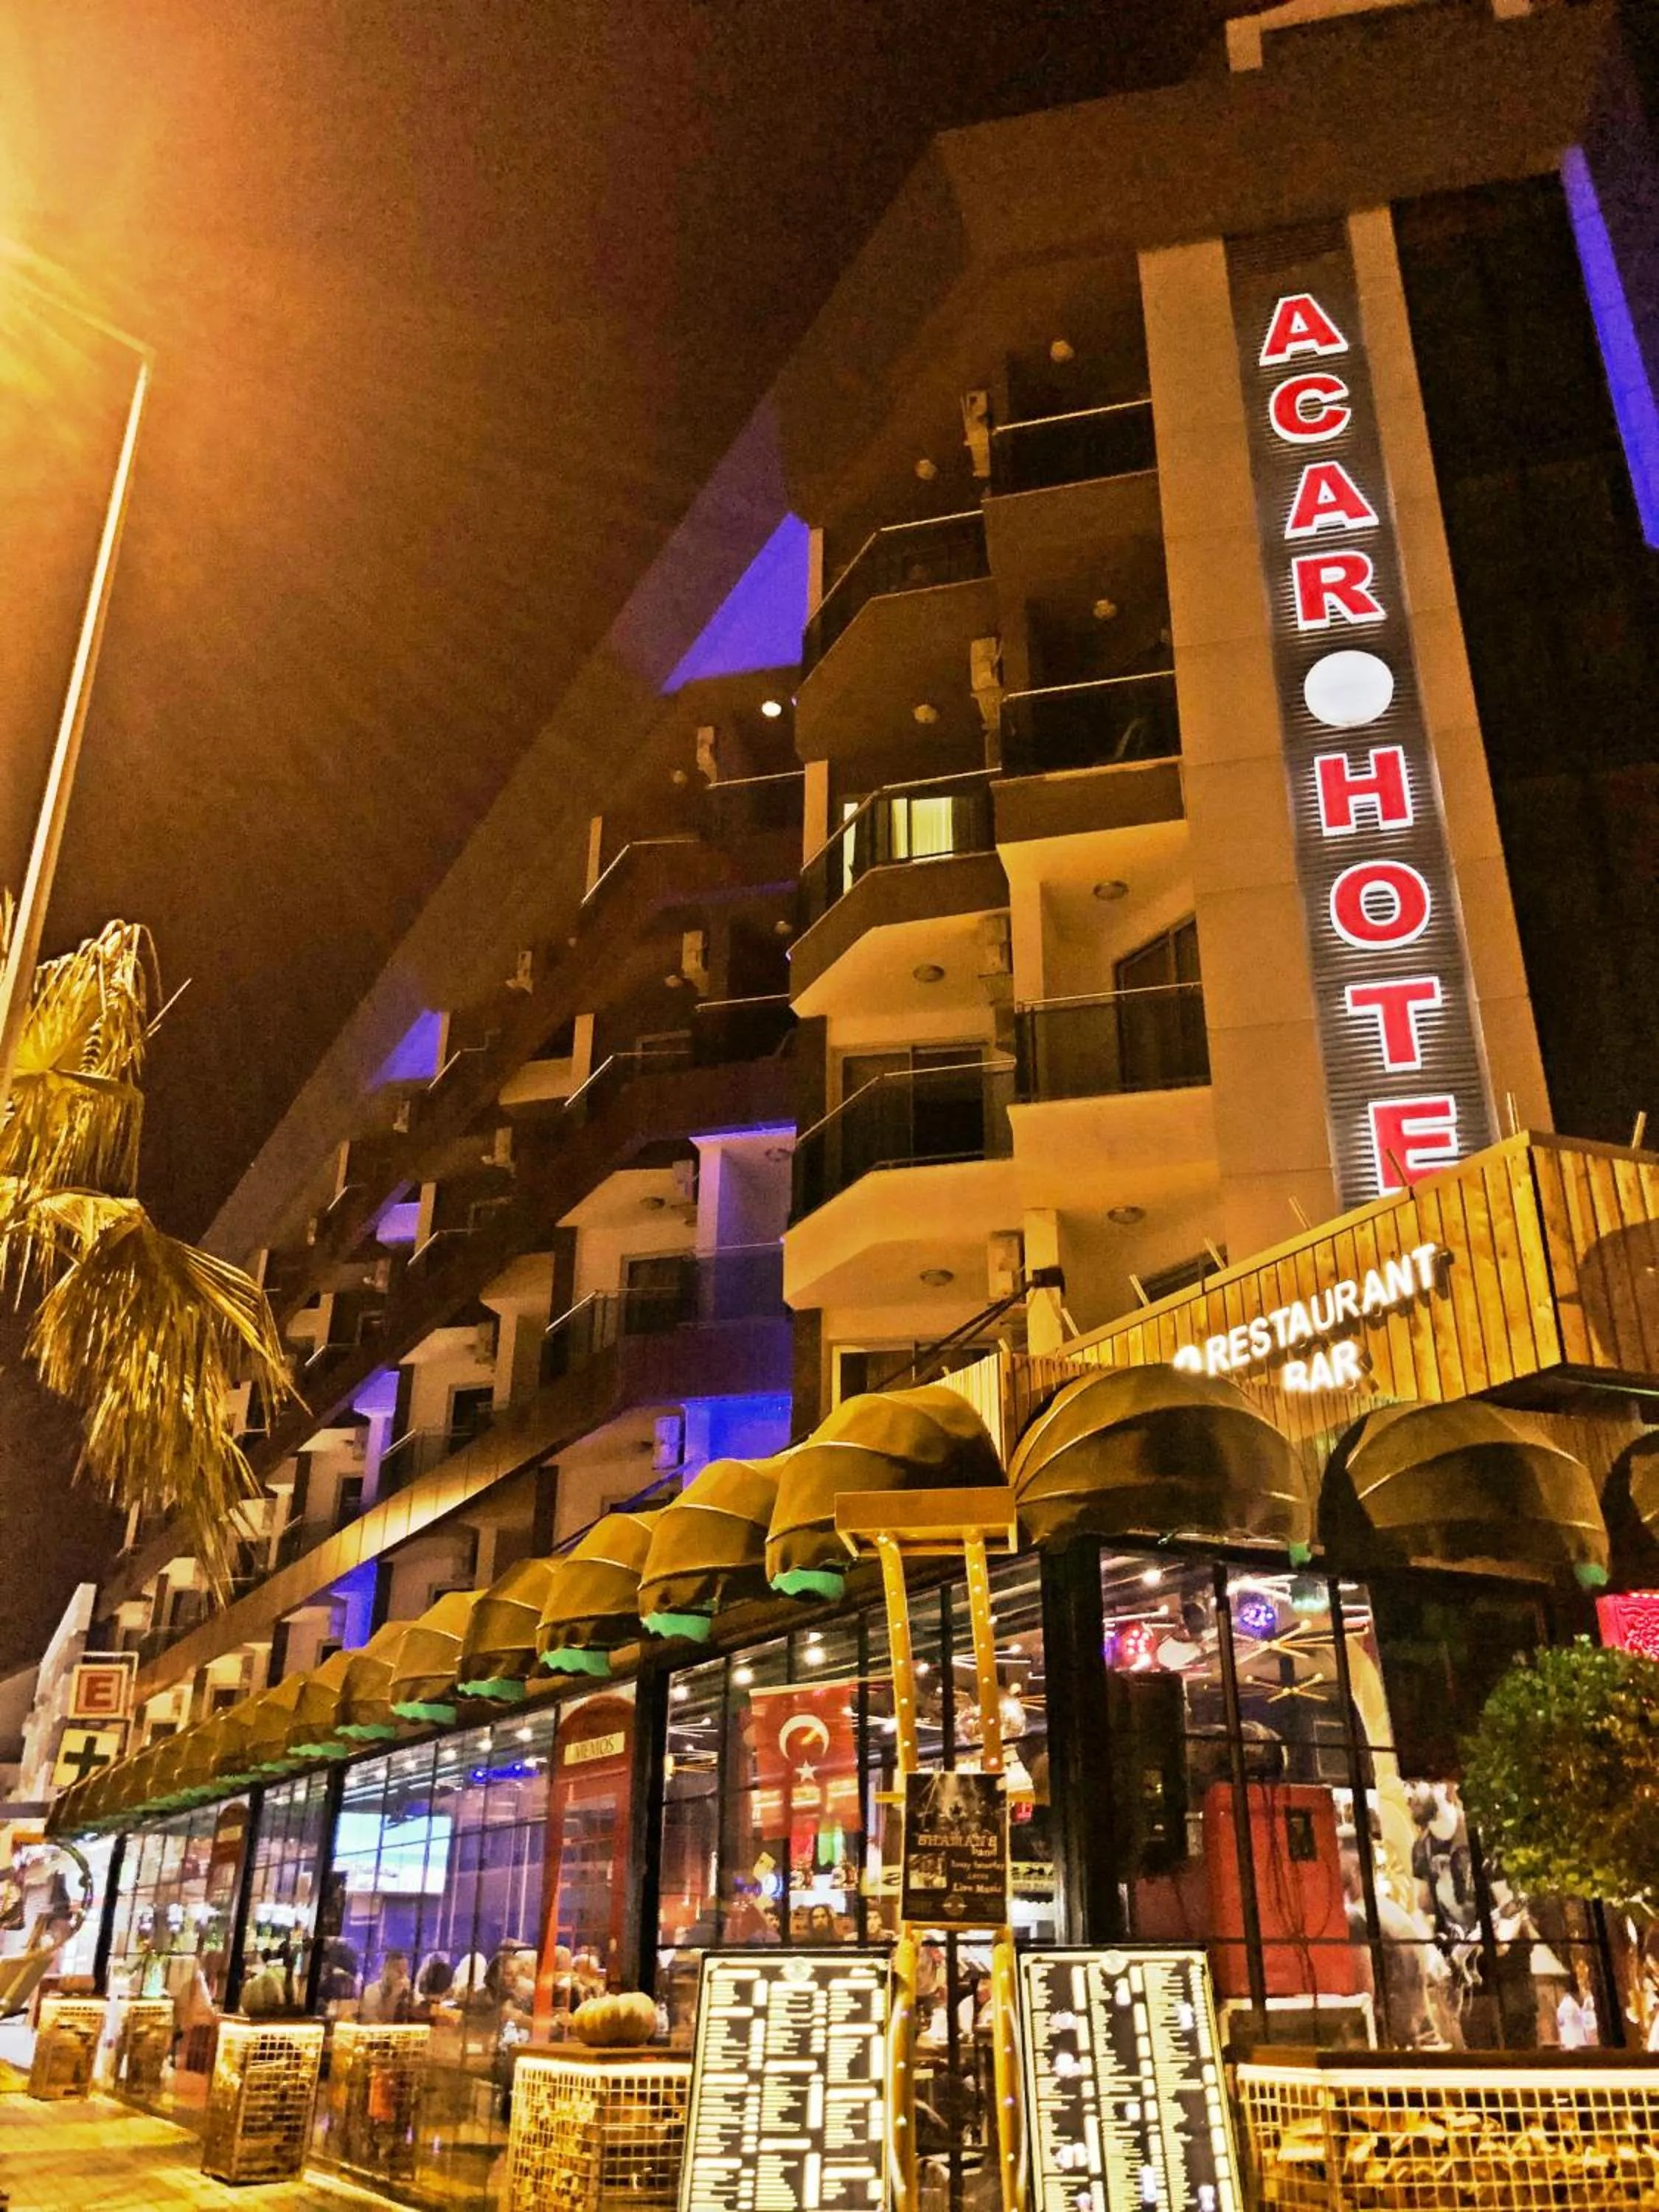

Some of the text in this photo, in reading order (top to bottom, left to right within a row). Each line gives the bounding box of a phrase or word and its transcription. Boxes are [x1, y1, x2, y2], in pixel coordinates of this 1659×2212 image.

[1259, 293, 1387, 631] ACAR
[1206, 1242, 1437, 1377] RESTAURANT
[1282, 1340, 1361, 1391] BAR
[85, 1676, 114, 1707] E
